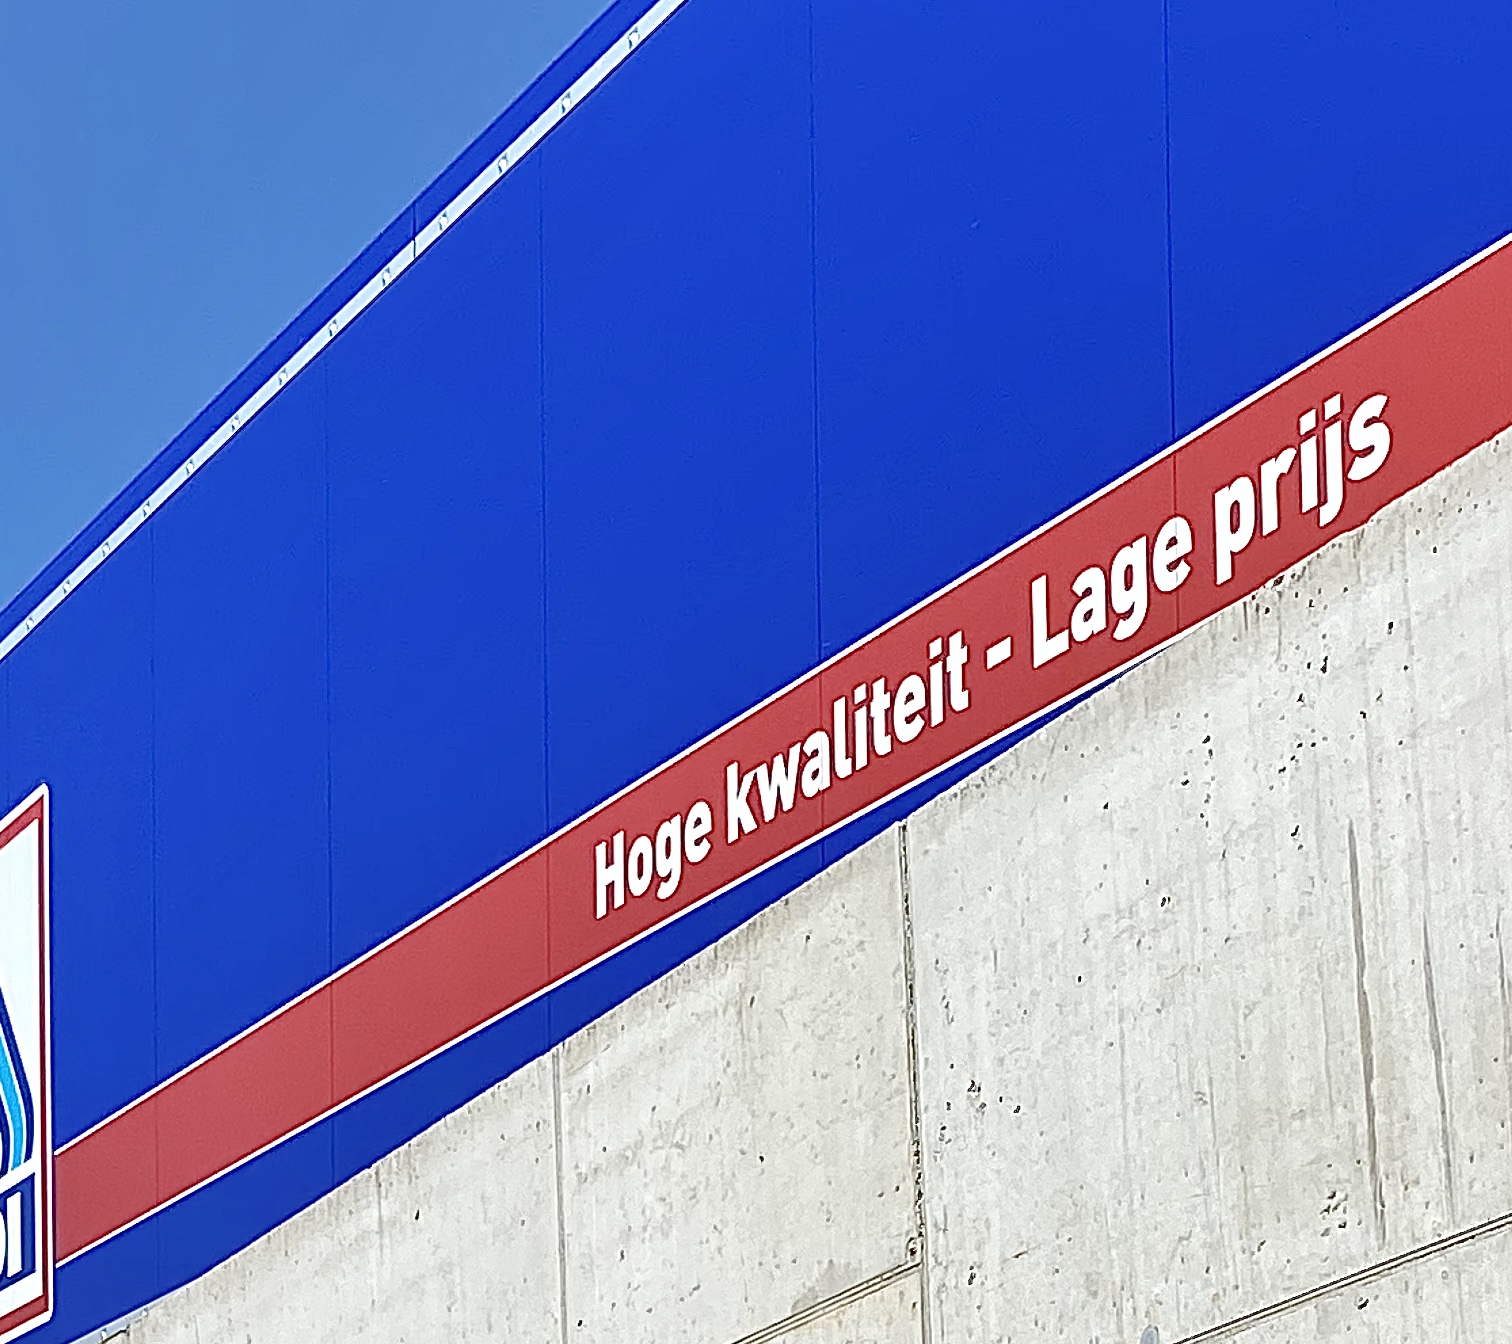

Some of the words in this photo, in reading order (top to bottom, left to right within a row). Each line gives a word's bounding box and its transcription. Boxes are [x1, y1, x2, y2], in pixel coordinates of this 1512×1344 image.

[594, 800, 712, 918] Hoge
[725, 630, 970, 845] kwaliteit
[1031, 514, 1194, 670] Lage
[1214, 391, 1392, 586] prijs
